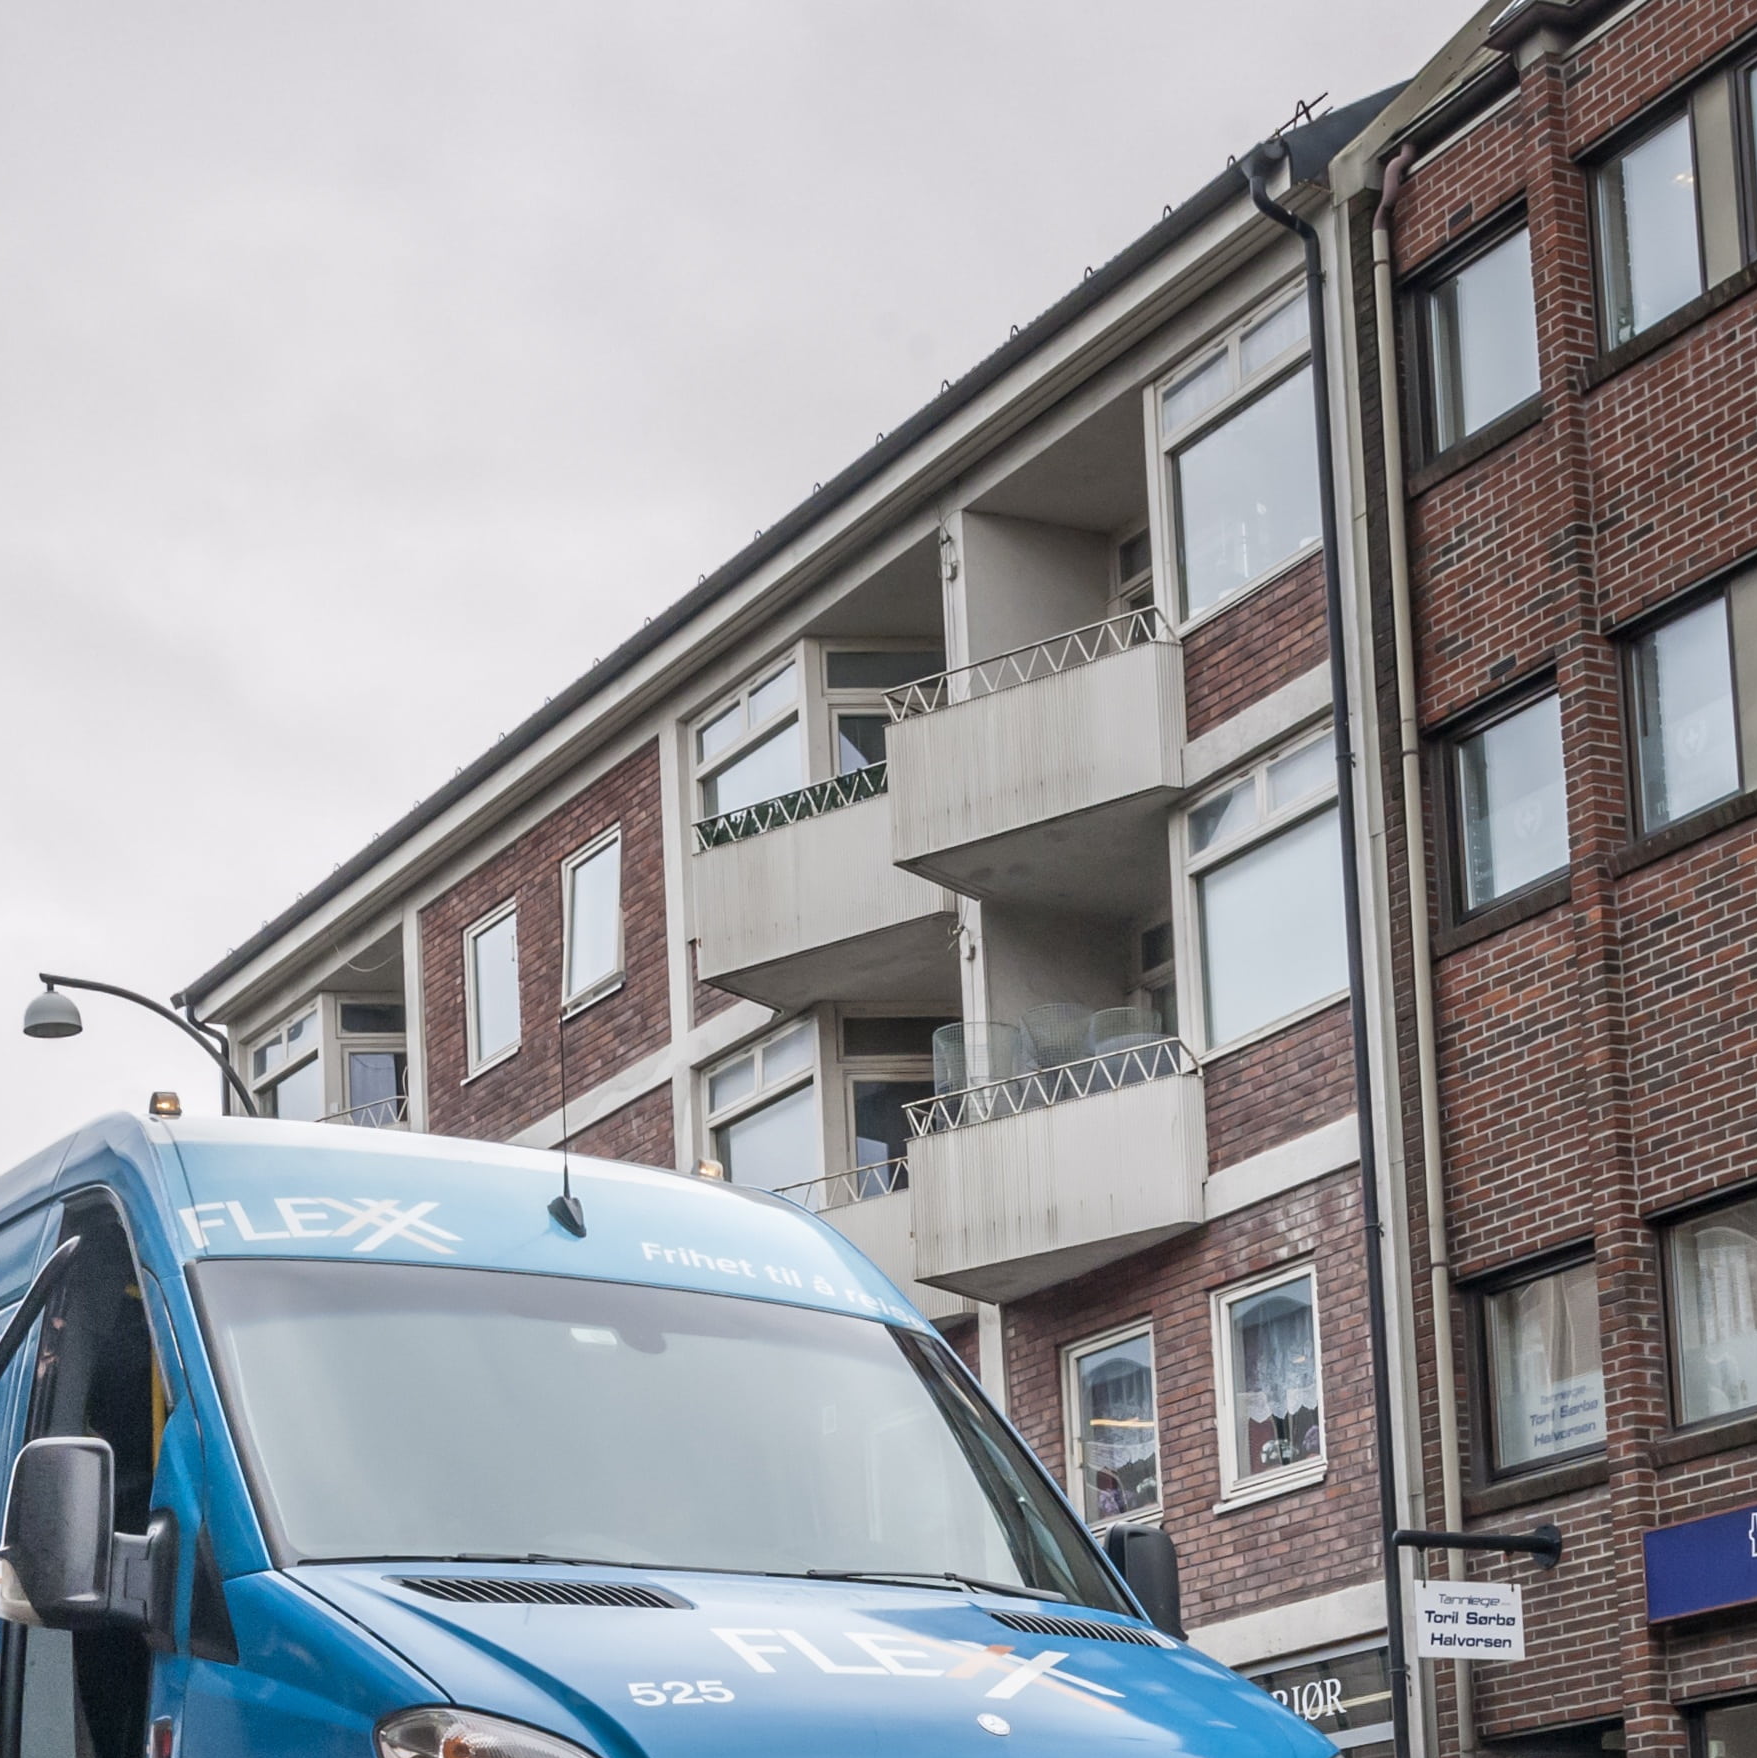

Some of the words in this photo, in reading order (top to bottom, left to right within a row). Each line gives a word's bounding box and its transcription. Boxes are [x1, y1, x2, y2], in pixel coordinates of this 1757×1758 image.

[641, 1241, 757, 1278] Frihet
[763, 1263, 803, 1288] til
[812, 1273, 836, 1297] å
[1424, 1610, 1459, 1624] Toril
[1466, 1612, 1516, 1627] Sørbø
[1430, 1633, 1512, 1649] Halvorsen
[627, 1680, 735, 1706] 525
